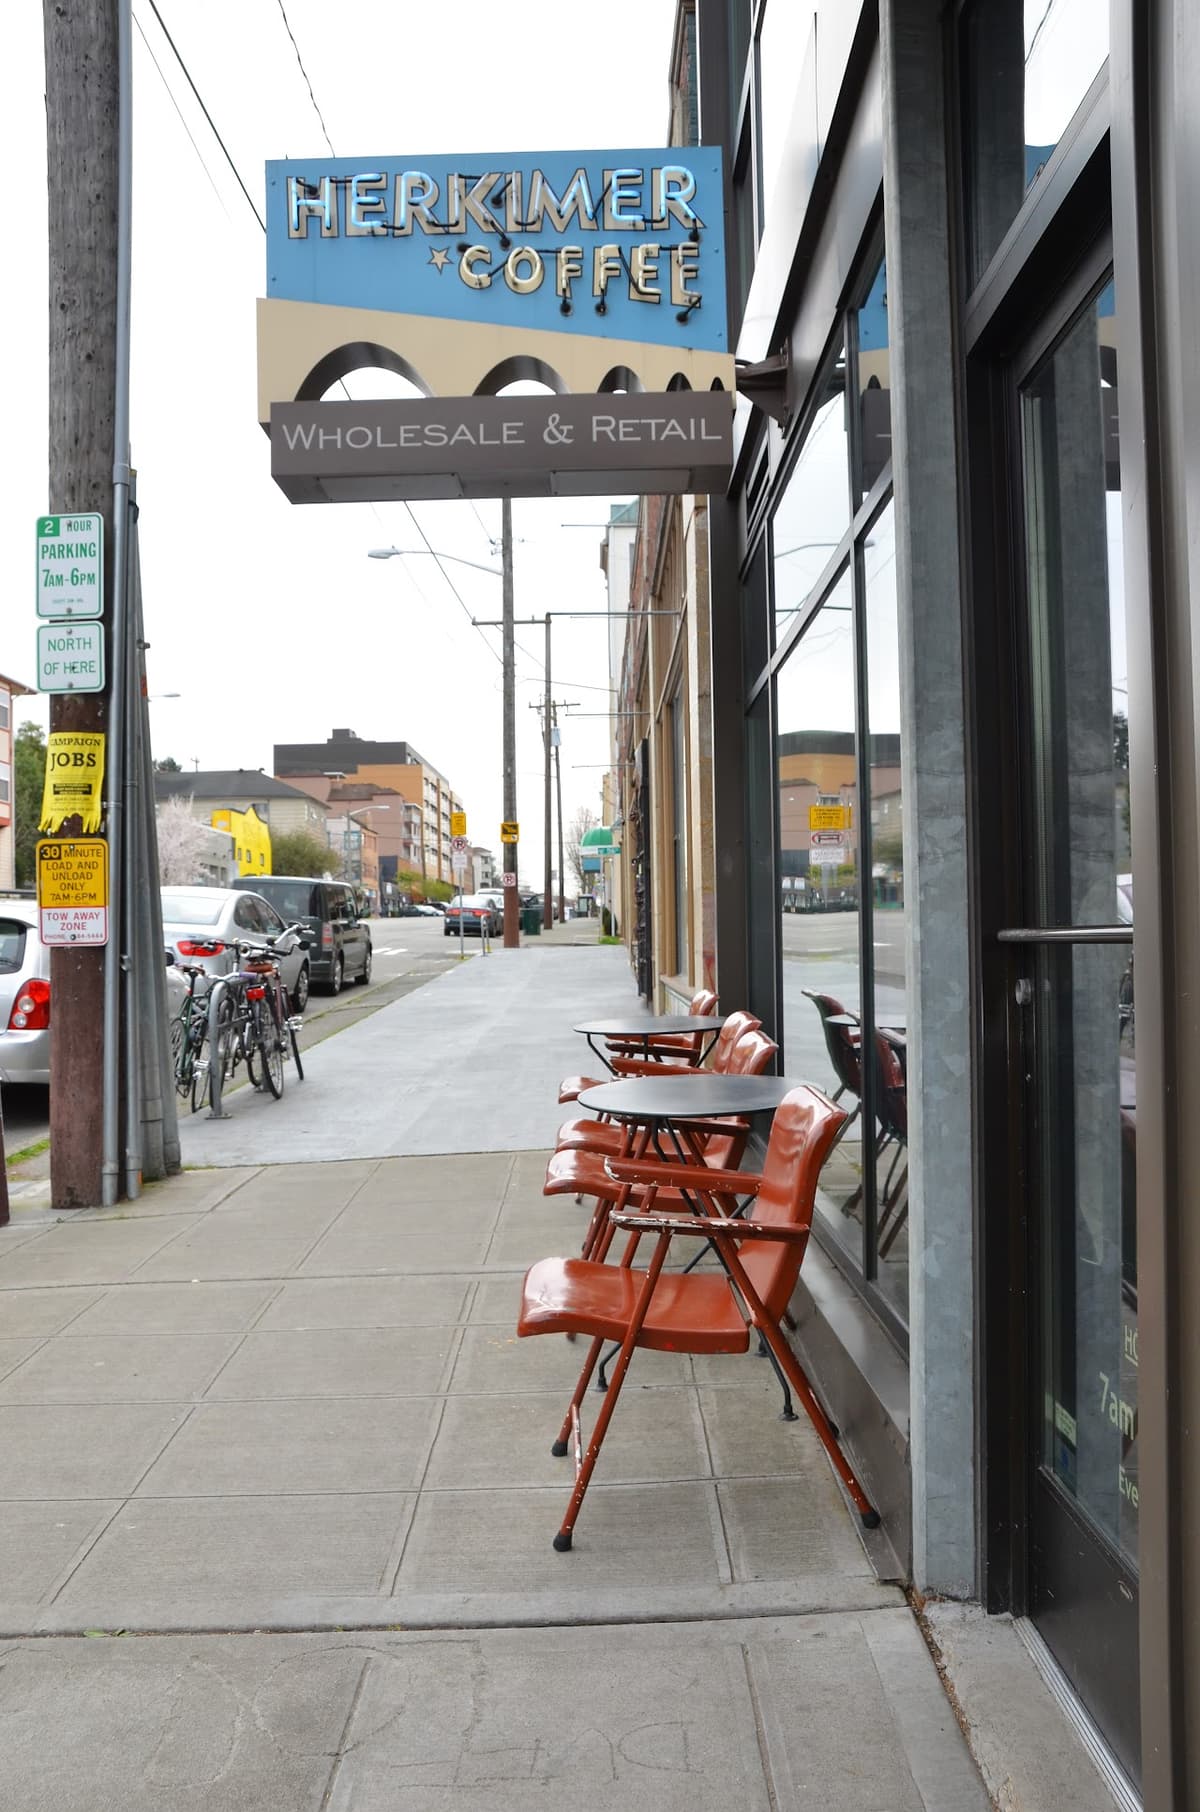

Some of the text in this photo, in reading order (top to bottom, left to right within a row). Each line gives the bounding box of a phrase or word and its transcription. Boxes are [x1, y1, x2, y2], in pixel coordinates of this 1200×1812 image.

[287, 165, 705, 239] HERKIMER
[458, 243, 701, 307] COFFEE
[282, 413, 722, 450] WHOLESALE & RETAIL
[44, 520, 92, 534] 2 HOUR
[41, 542, 97, 560] PARKING
[42, 567, 96, 587] 7AM-6PM
[48, 637, 92, 652] NORTH
[44, 660, 96, 676] OF HERE
[50, 752, 96, 771] JOBS
[43, 846, 102, 858] 30 MINUTE
[46, 861, 99, 870] LOAD AND
[52, 871, 93, 881] UNLOAD
[59, 882, 85, 891] ONLY
[49, 892, 97, 901] 7AM-6PM
[47, 911, 100, 921] TOW AWAY
[60, 921, 87, 931] ZONE
[1099, 1371, 1135, 1441] 7am
